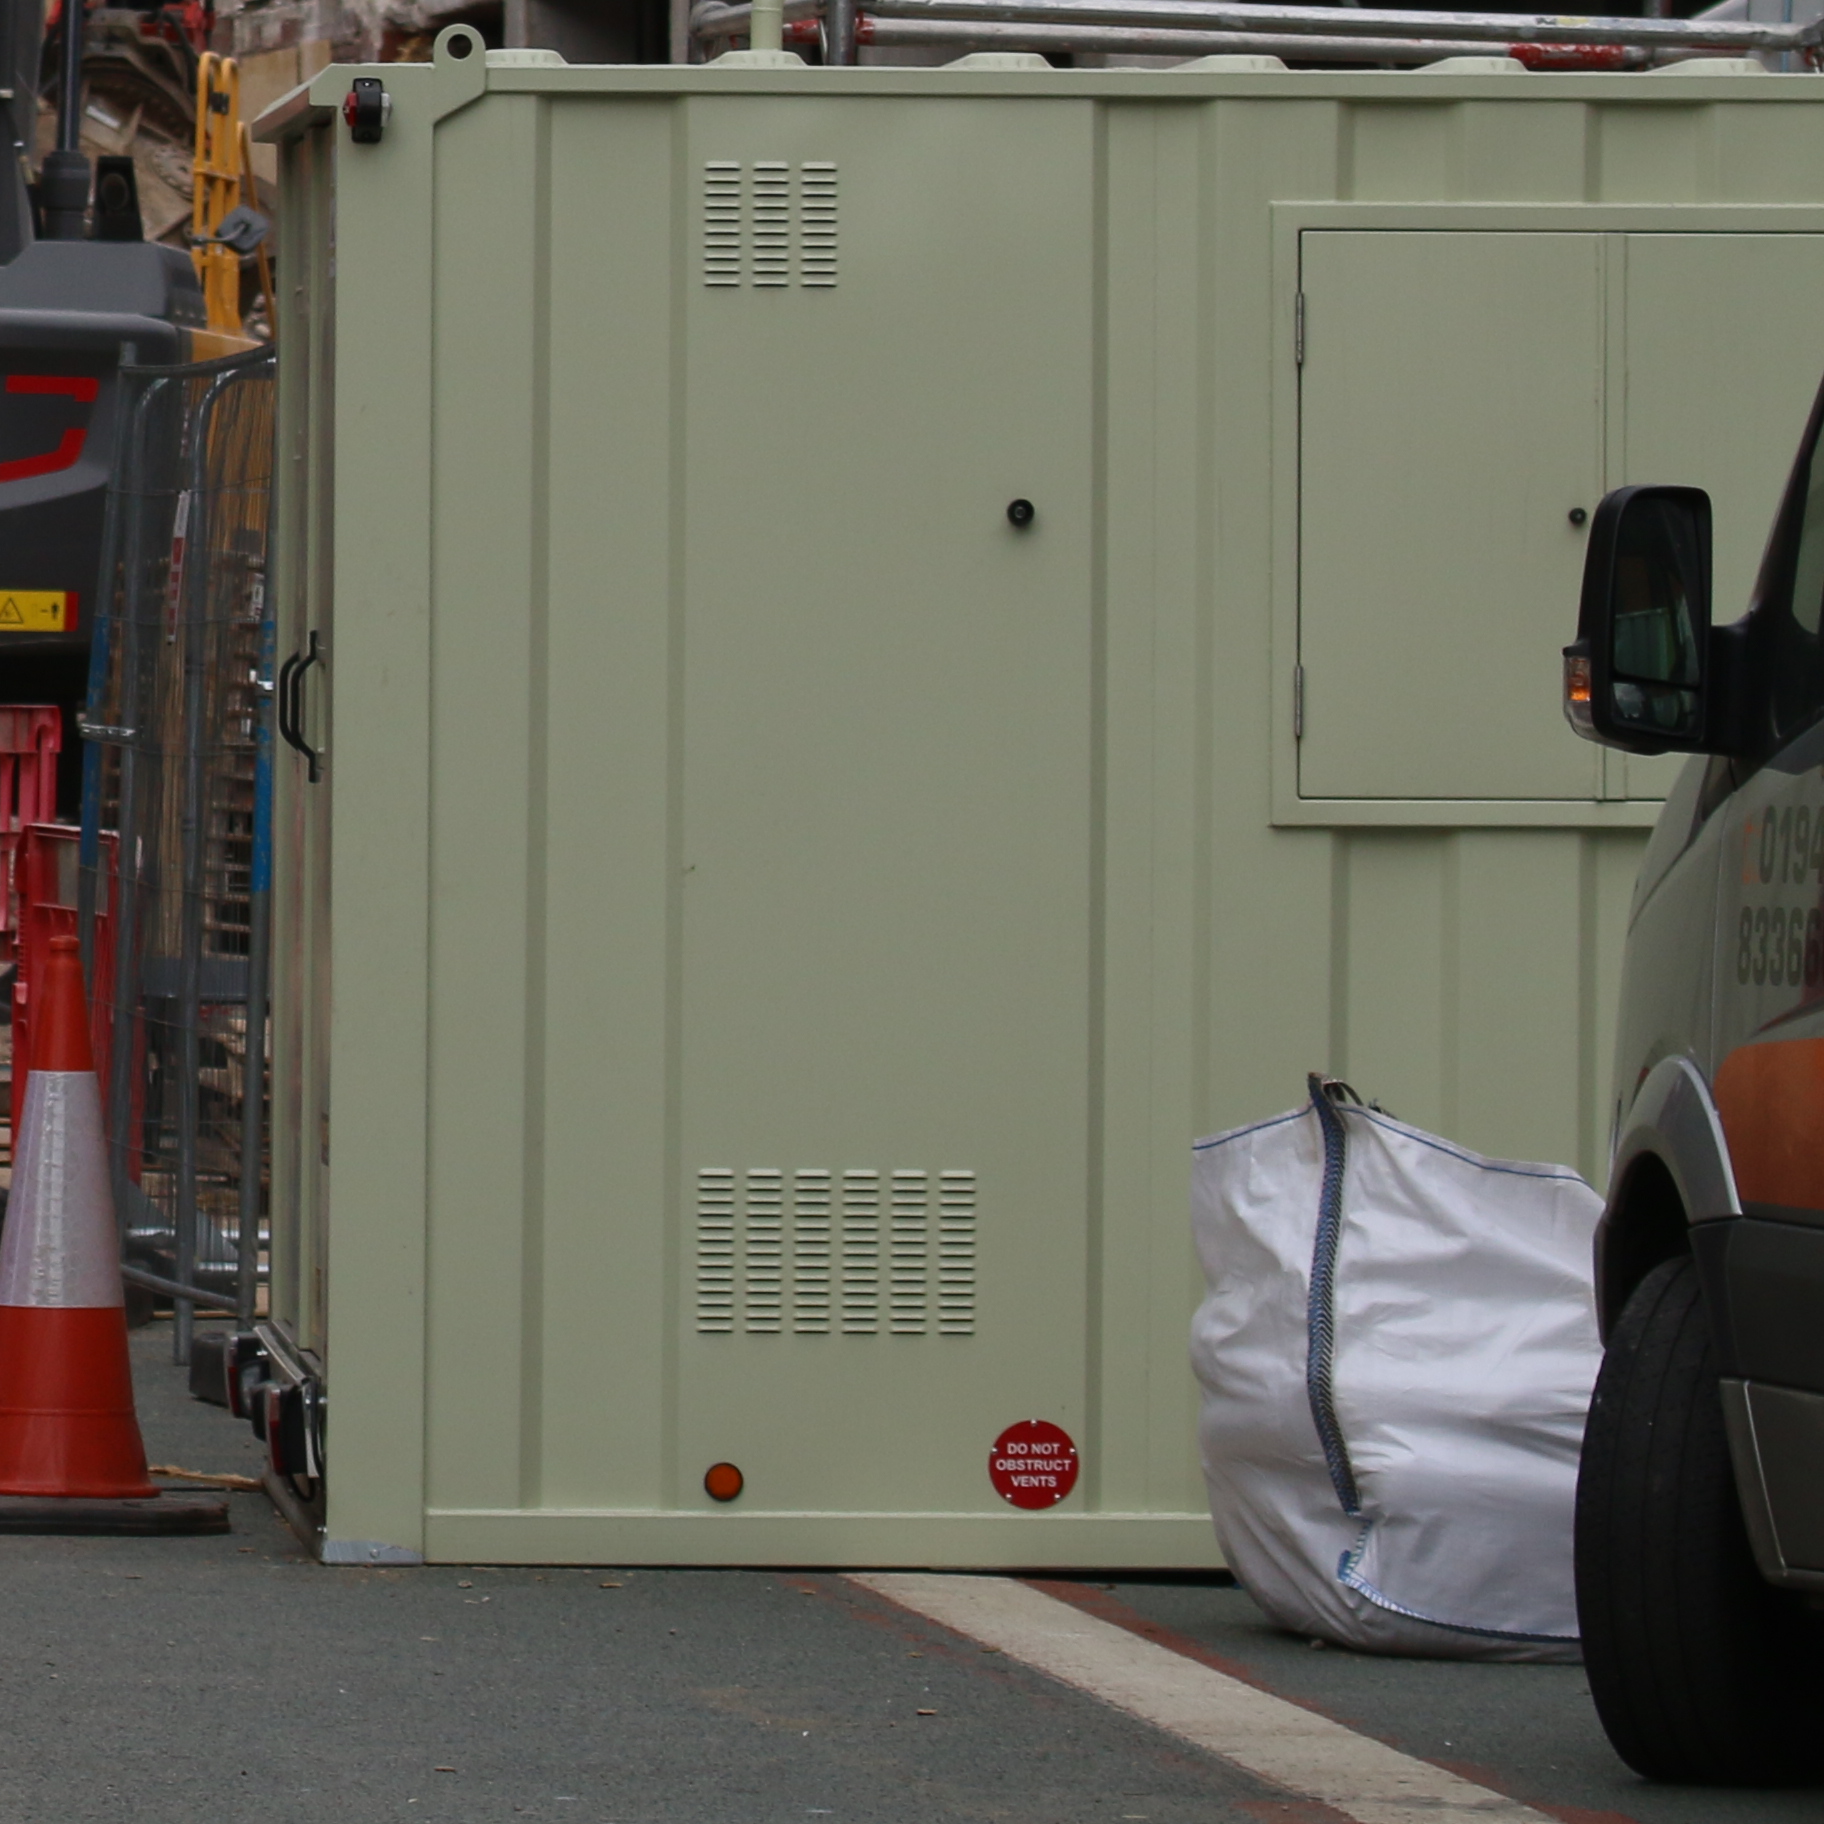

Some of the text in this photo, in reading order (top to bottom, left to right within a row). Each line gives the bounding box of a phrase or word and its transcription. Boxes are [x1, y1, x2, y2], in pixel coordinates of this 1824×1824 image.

[1006, 1442, 1060, 1455] DO NOT
[995, 1459, 1072, 1471] OBSTRUCT
[1010, 1475, 1057, 1487] VENTS
